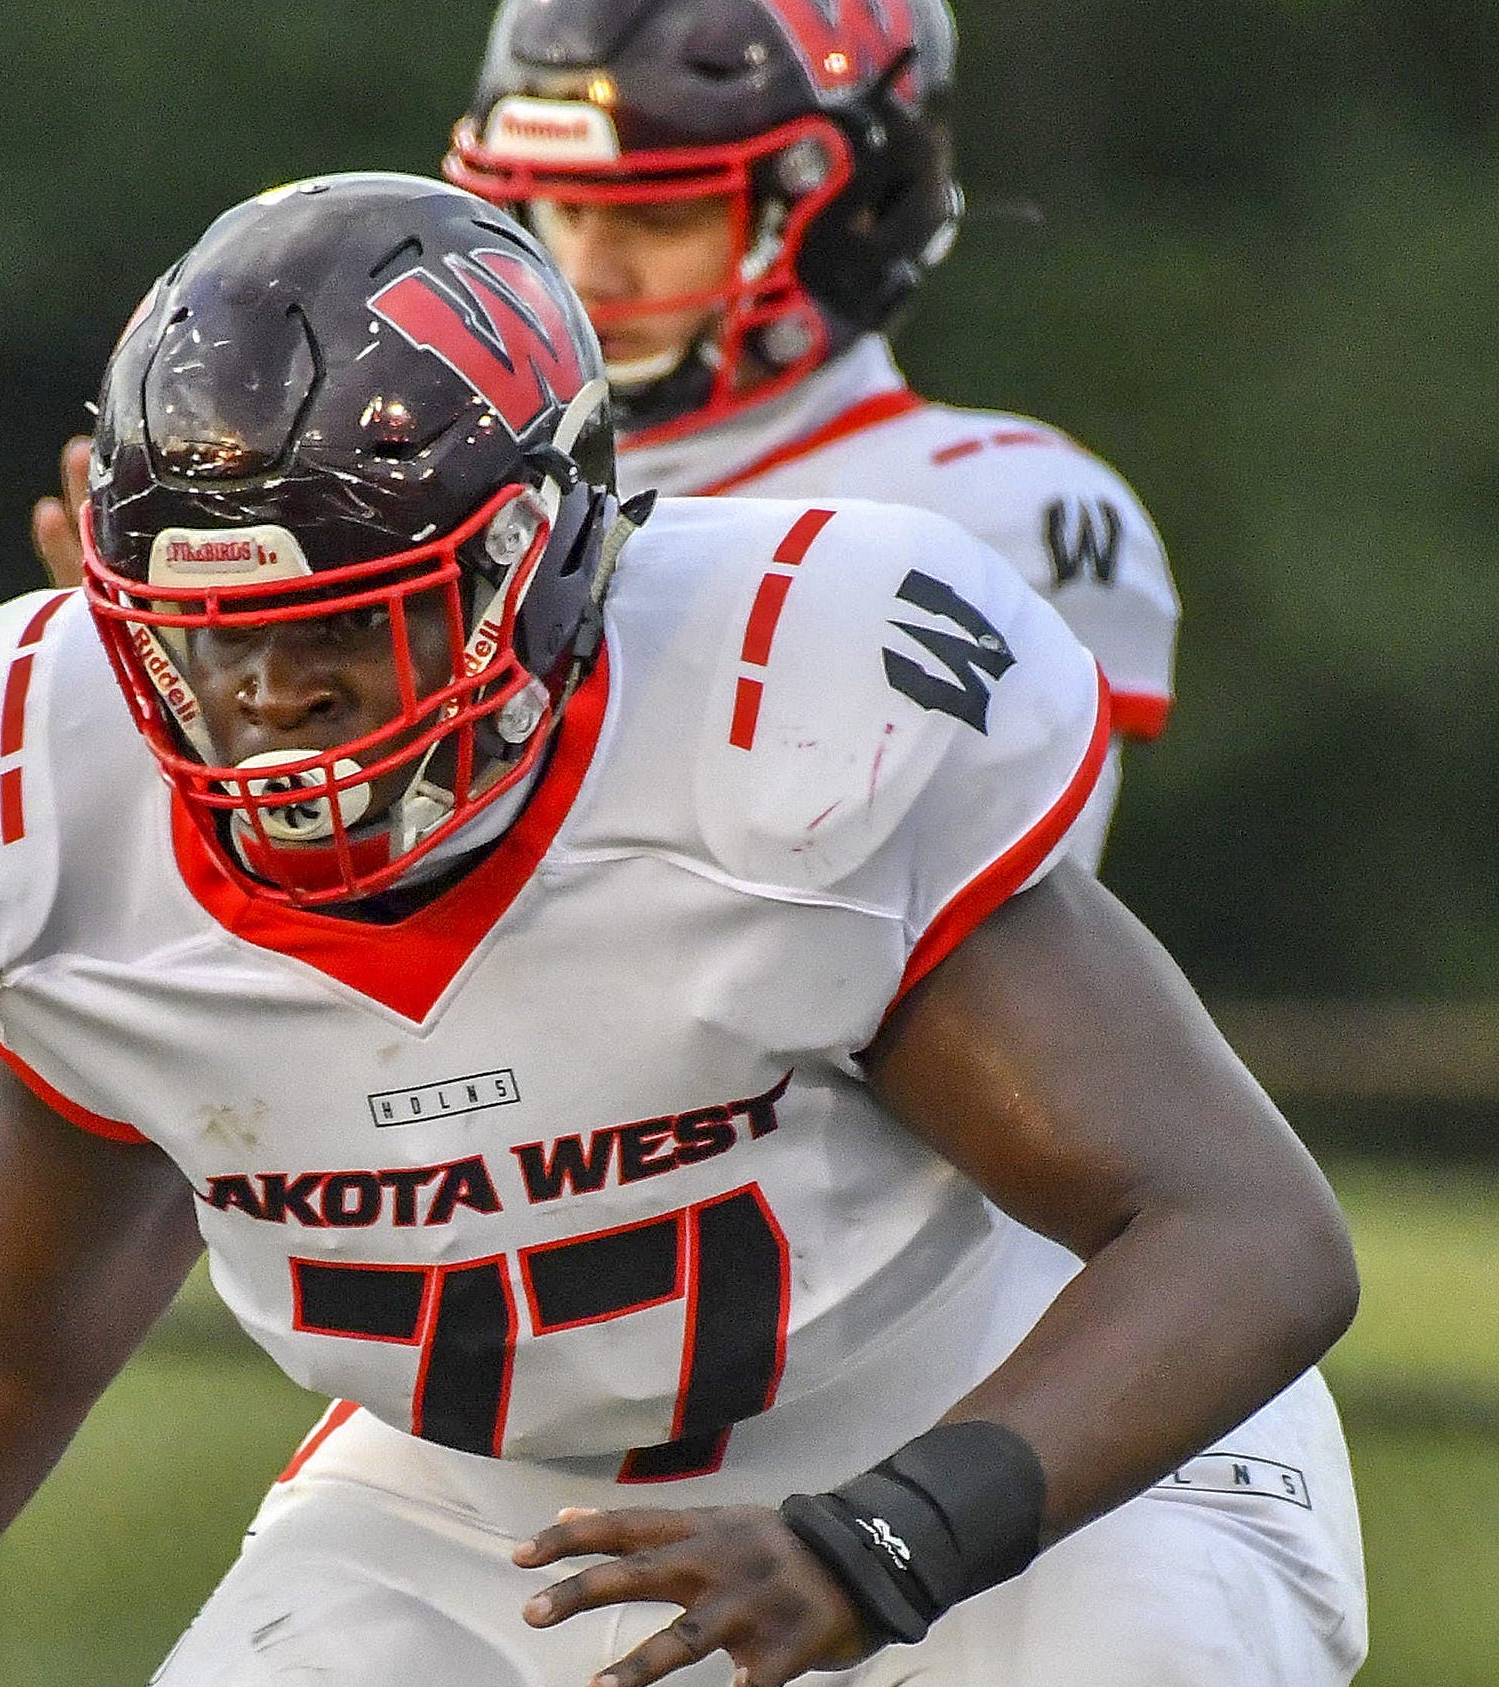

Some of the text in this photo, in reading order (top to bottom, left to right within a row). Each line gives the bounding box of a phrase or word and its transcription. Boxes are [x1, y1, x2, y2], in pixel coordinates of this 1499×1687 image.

[366, 247, 585, 444] W
[1043, 496, 1122, 588] W
[882, 567, 1016, 737] W
[196, 1066, 795, 1228] AKOTA WEST
[288, 1181, 790, 1485] 77
[1173, 1462, 1296, 1495] LNS
